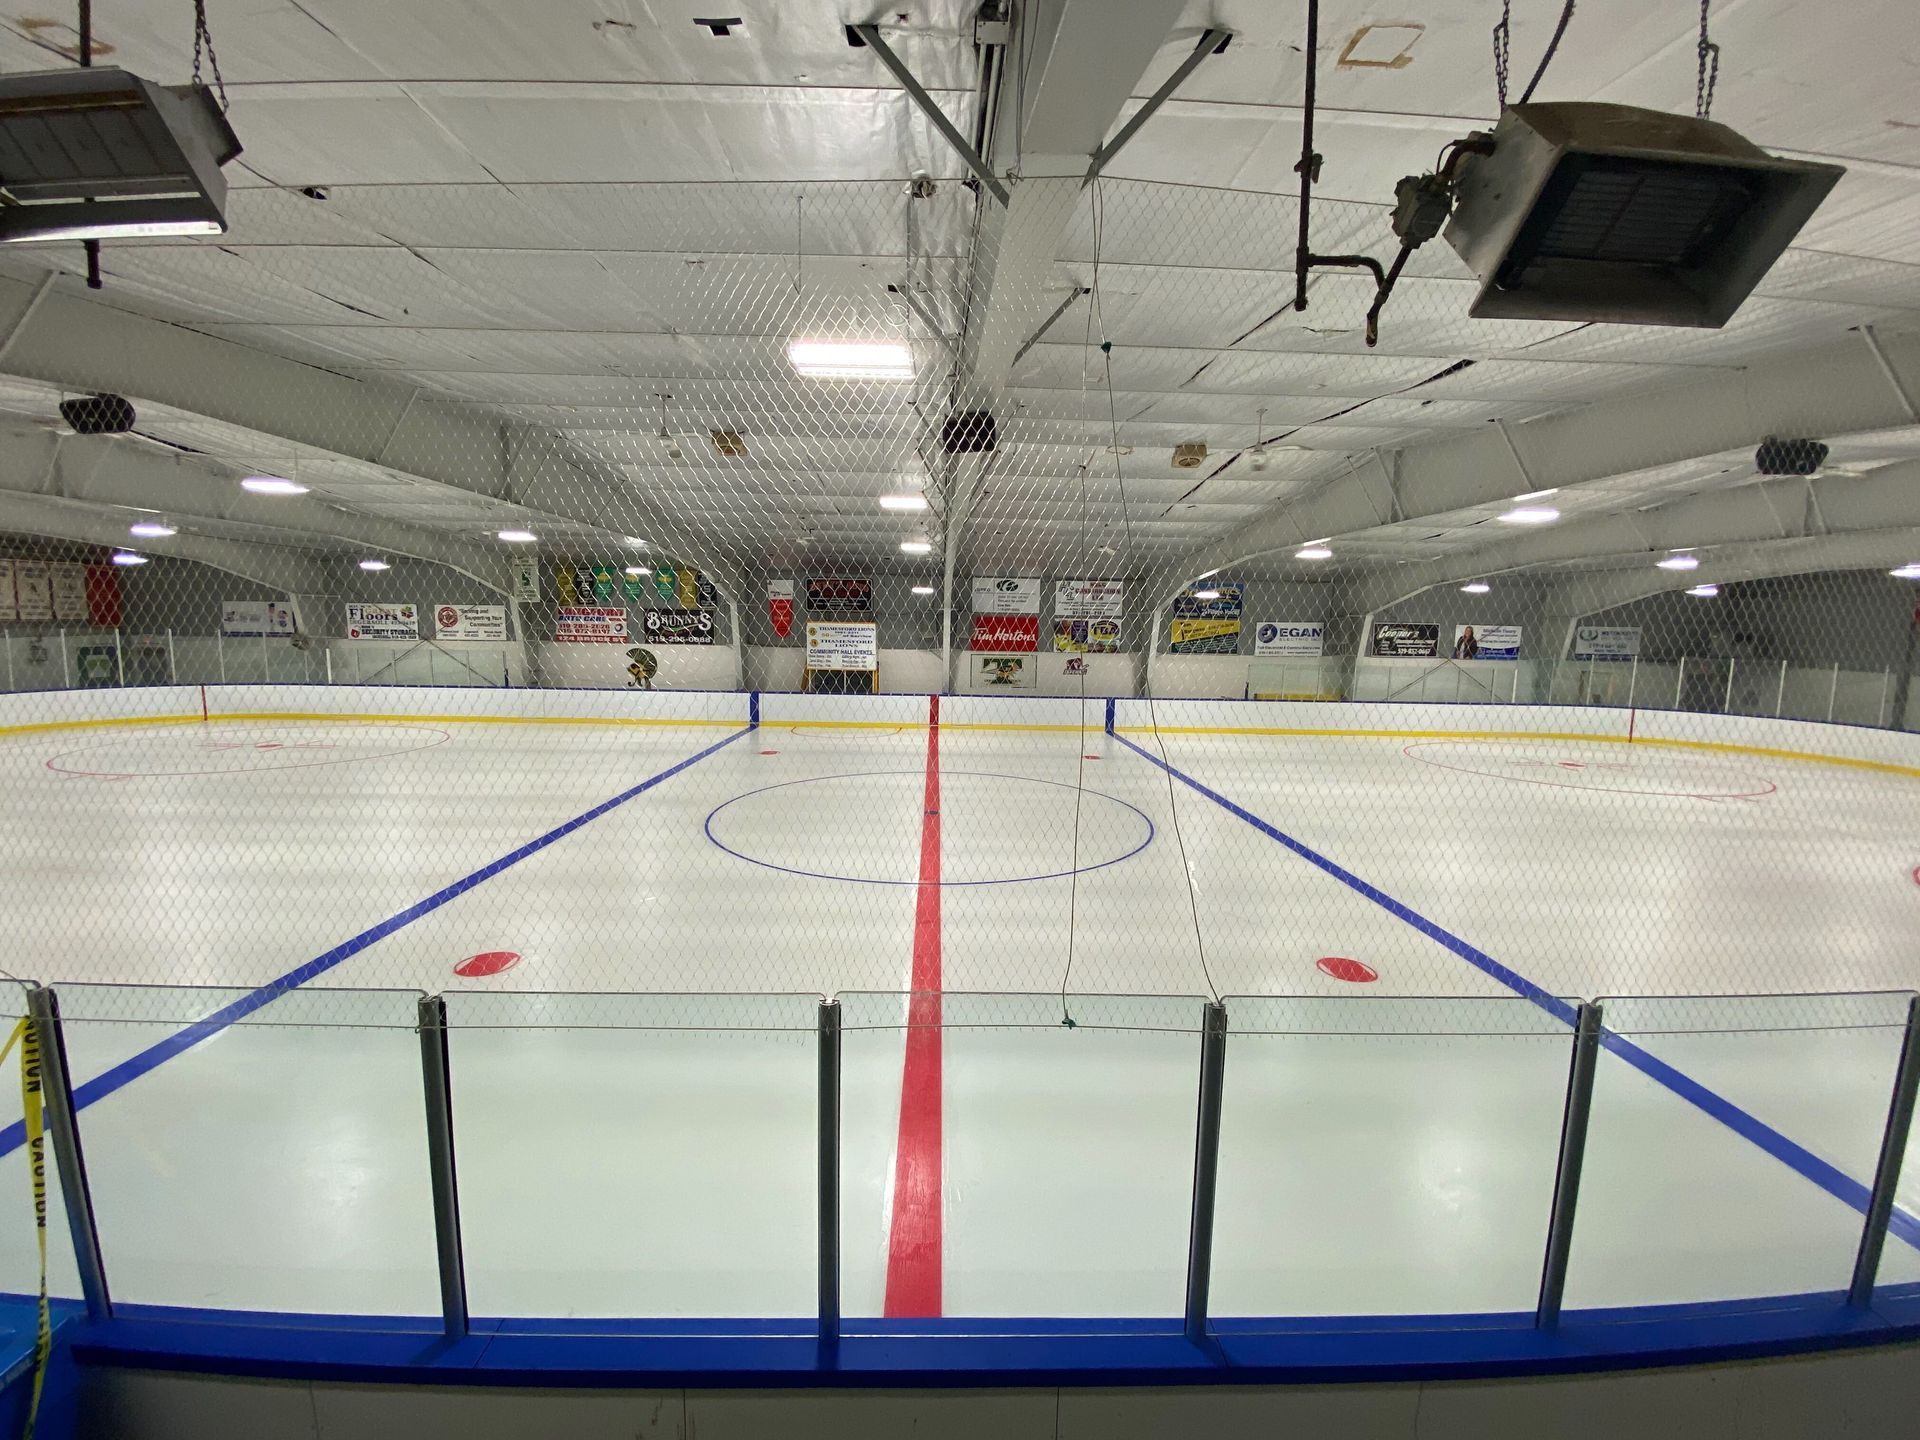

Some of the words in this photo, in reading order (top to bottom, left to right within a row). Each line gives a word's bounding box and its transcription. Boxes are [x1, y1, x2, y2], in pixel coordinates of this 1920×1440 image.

[349, 608, 398, 620] Floors
[973, 627, 993, 641] Tim
[993, 627, 1036, 641] Hortons
[1279, 627, 1322, 638] EGAN
[32, 1136, 47, 1227] CAUTION
